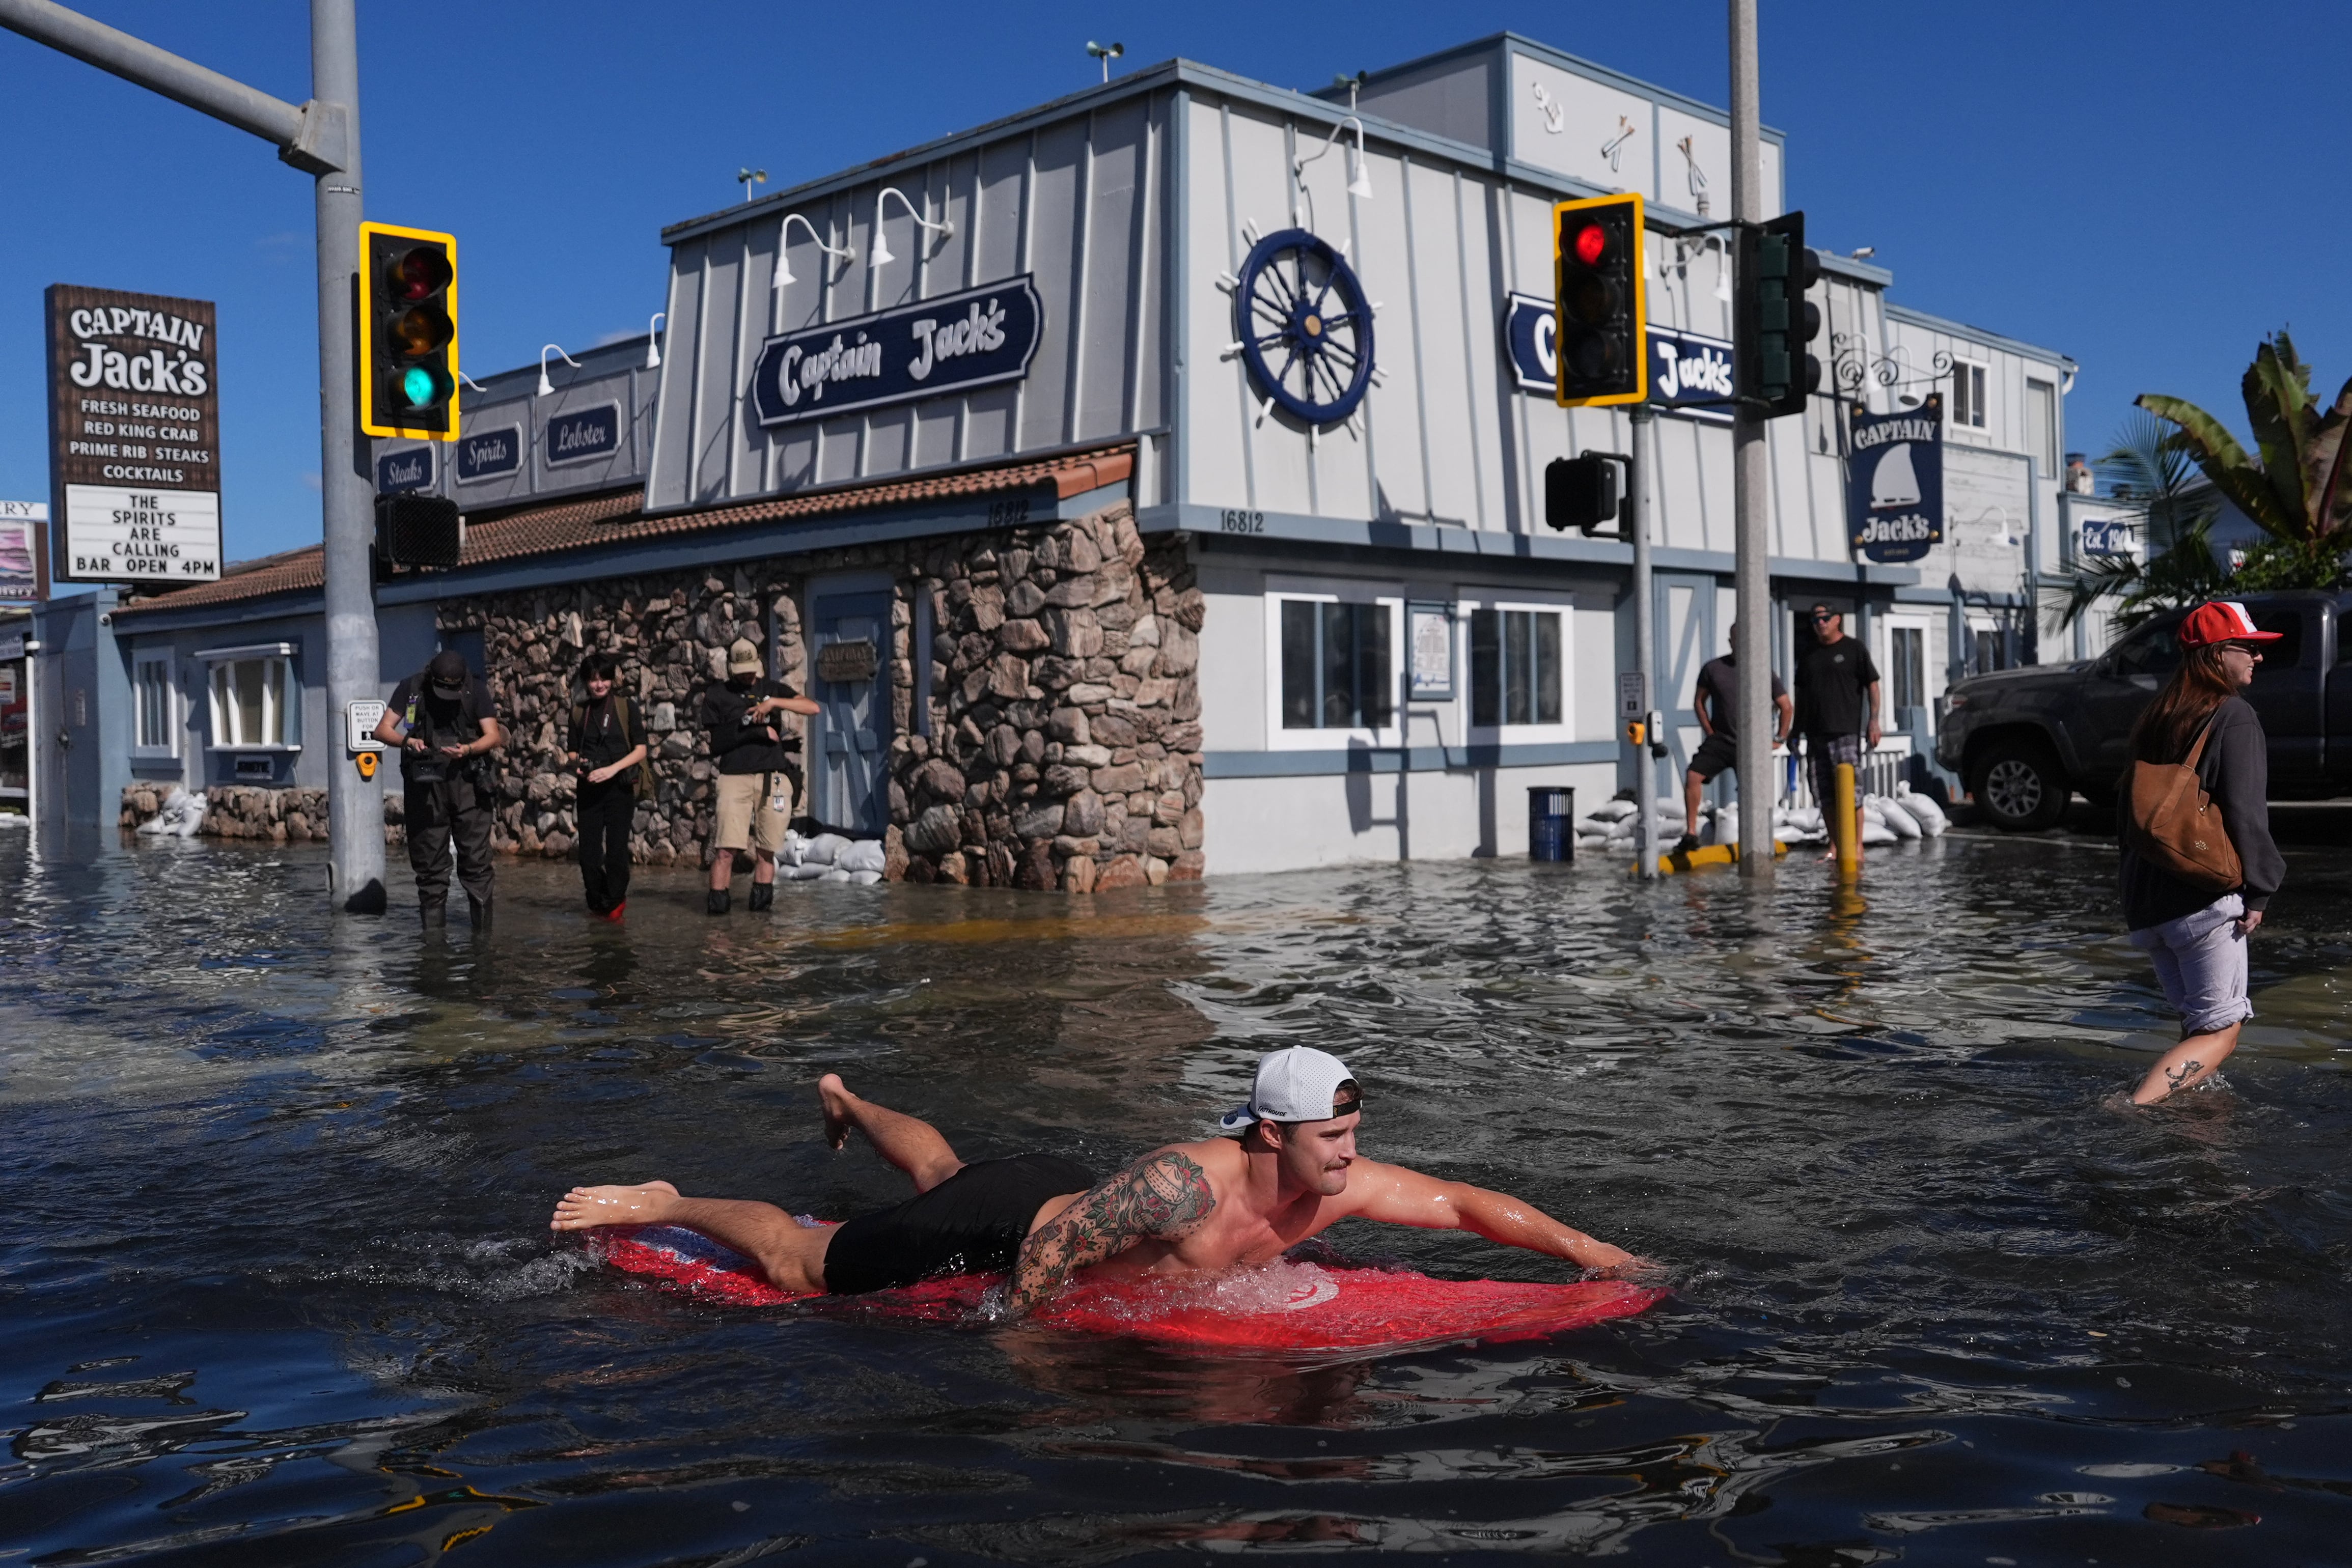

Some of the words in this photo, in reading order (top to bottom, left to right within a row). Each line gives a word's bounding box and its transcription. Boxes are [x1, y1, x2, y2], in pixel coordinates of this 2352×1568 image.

[70, 307, 204, 351] CAPTAIN
[778, 331, 881, 407] Captain
[908, 297, 1006, 381] Jack's
[70, 343, 208, 396] Jack's
[1656, 341, 1733, 398] Jack's
[81, 399, 128, 416] FRESH
[132, 404, 201, 422] SEAFOOD
[84, 421, 115, 436] RED
[119, 423, 156, 439] KING
[160, 427, 199, 442] CRAB
[558, 421, 606, 452] Lobster
[1855, 418, 1936, 450] CAPTAIN
[69, 441, 118, 457] PRIME
[122, 444, 147, 459] RIB
[155, 447, 209, 464] STEAKS
[468, 438, 507, 472] Spirits
[103, 464, 183, 482] COCKTAILS
[388, 457, 422, 485] Steaks
[0, 501, 34, 515] RY
[130, 495, 159, 509] THE
[988, 499, 1029, 525] 16812
[113, 511, 176, 526] SPIRITS
[1222, 510, 1264, 533] 16812
[1862, 513, 1929, 543] Jack's
[130, 527, 161, 542] ARE
[113, 542, 179, 558] CALLING
[77, 557, 111, 572] BAR
[126, 558, 167, 573] OPEN
[182, 561, 214, 575] 4PM
[1257, 1105, 1287, 1116] FASTHOUSE
